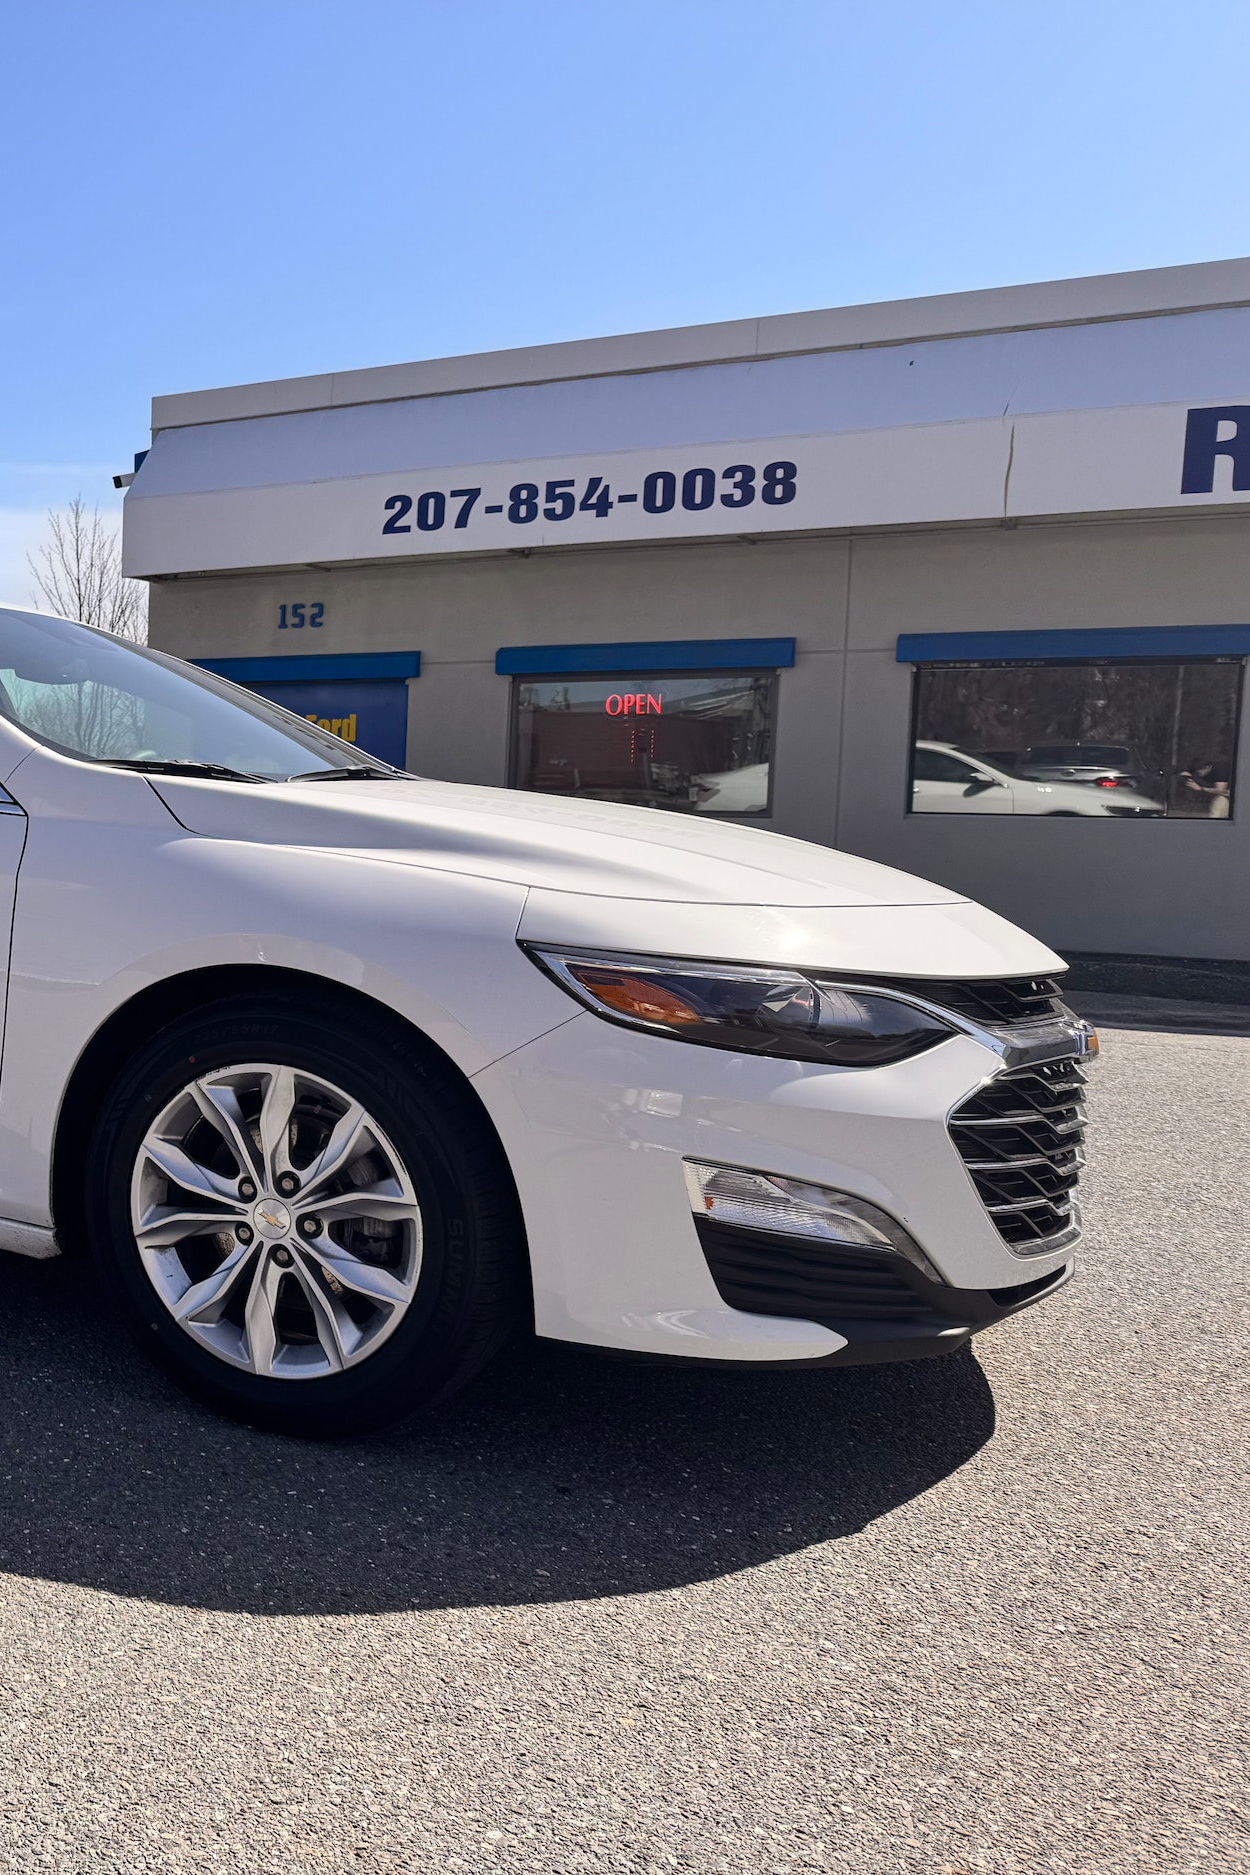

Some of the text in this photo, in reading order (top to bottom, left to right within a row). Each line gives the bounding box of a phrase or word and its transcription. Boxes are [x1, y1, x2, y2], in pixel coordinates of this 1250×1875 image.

[382, 461, 797, 534] 207-854-0038
[278, 602, 324, 629] 152
[605, 693, 662, 715] OPEN
[306, 713, 357, 742] rd
